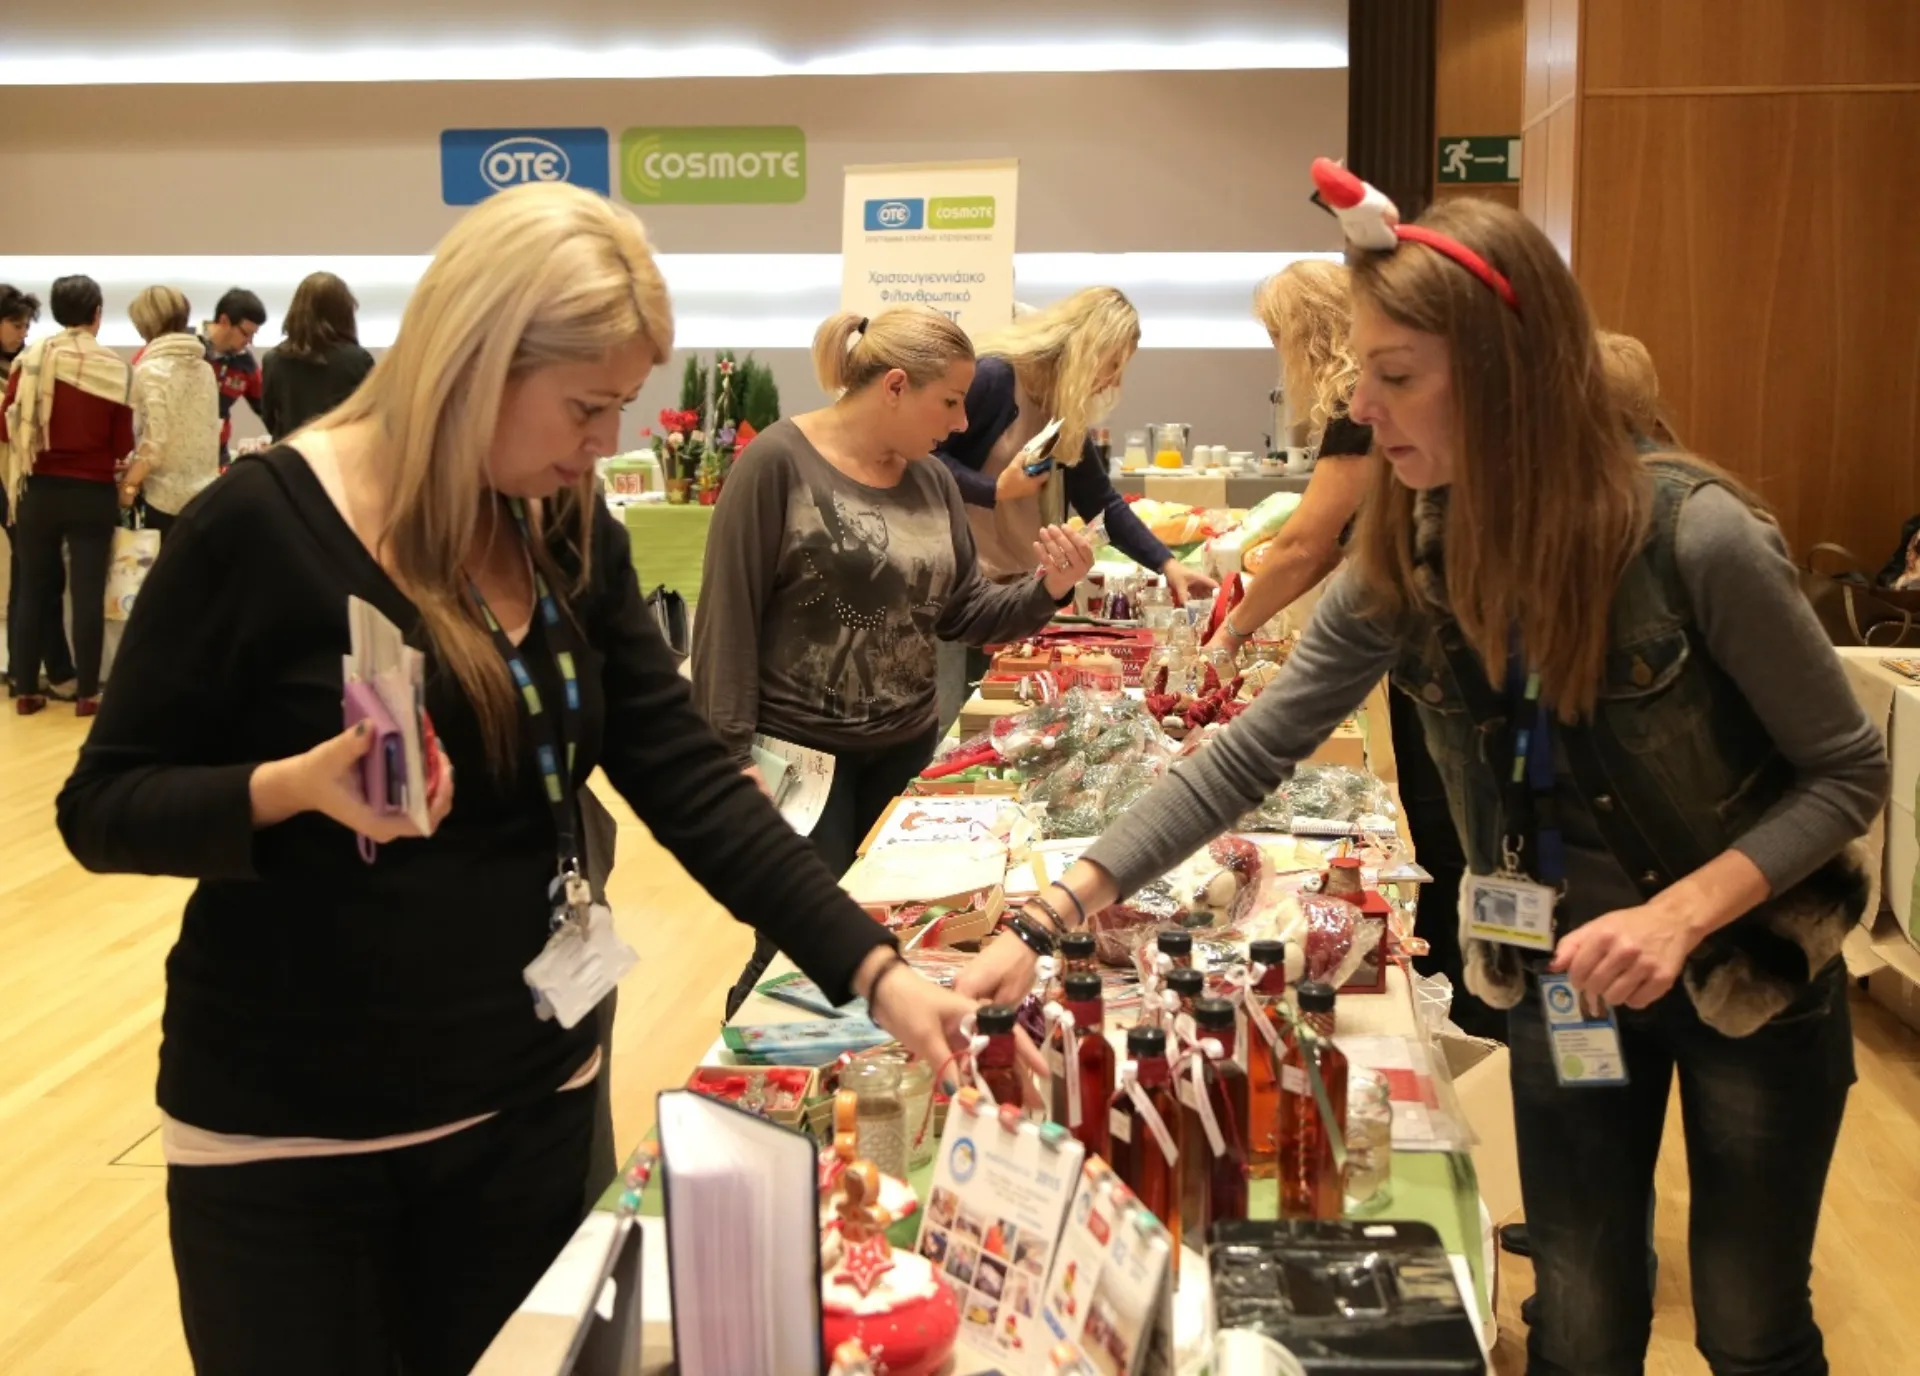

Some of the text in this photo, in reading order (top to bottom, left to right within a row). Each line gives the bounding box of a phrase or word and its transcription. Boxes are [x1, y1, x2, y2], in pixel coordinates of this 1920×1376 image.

[487, 151, 560, 182] OTE
[644, 151, 800, 179] COSMOTE
[880, 207, 907, 221] OTE
[936, 206, 994, 220] COSMOTE
